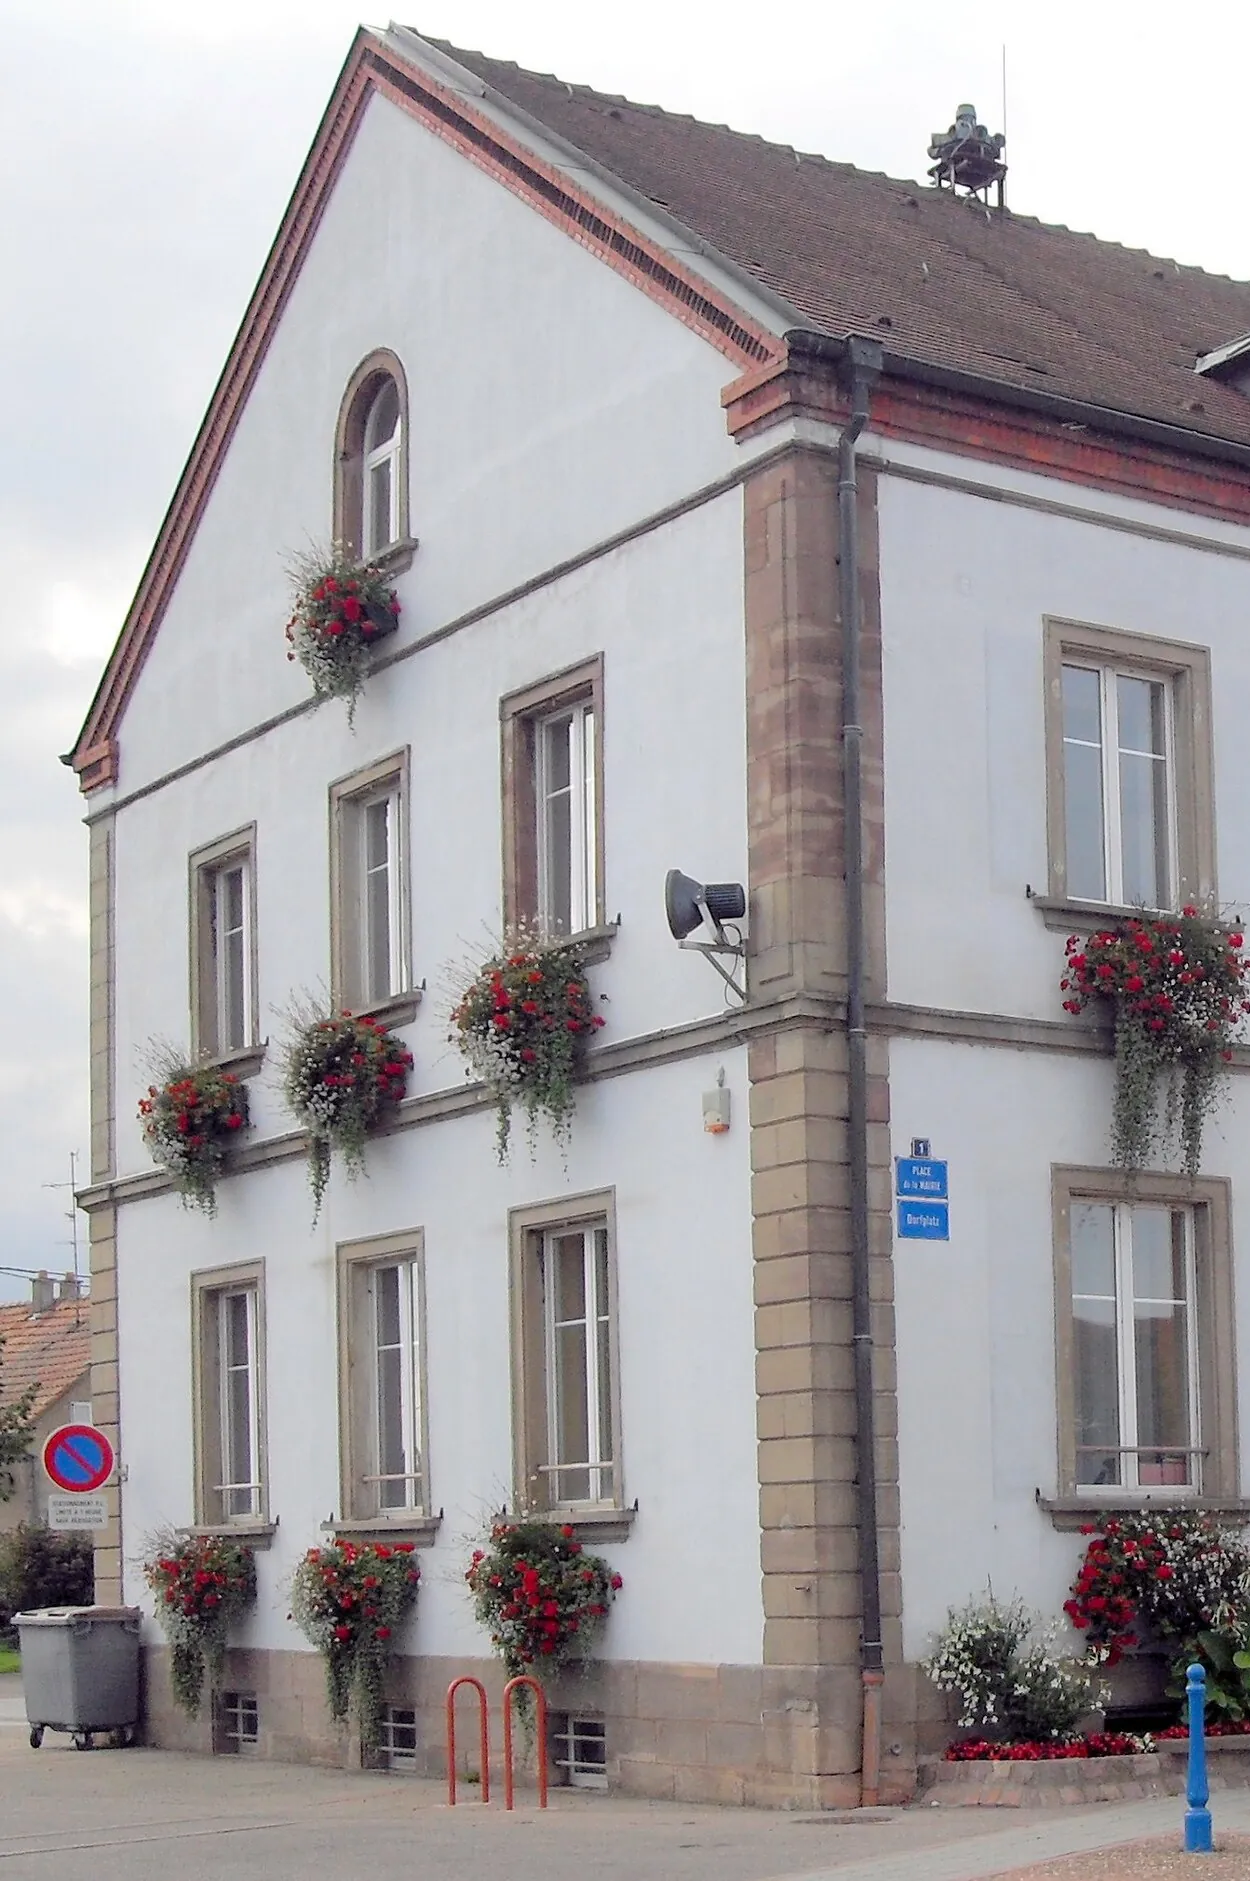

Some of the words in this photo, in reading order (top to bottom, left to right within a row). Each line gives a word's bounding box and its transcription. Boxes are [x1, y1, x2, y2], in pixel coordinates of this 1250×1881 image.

[911, 1166, 931, 1176] PLACE
[903, 1180, 910, 1189] de
[919, 1181, 941, 1191] MAIRIE
[906, 1214, 939, 1227] Dorfplatz
